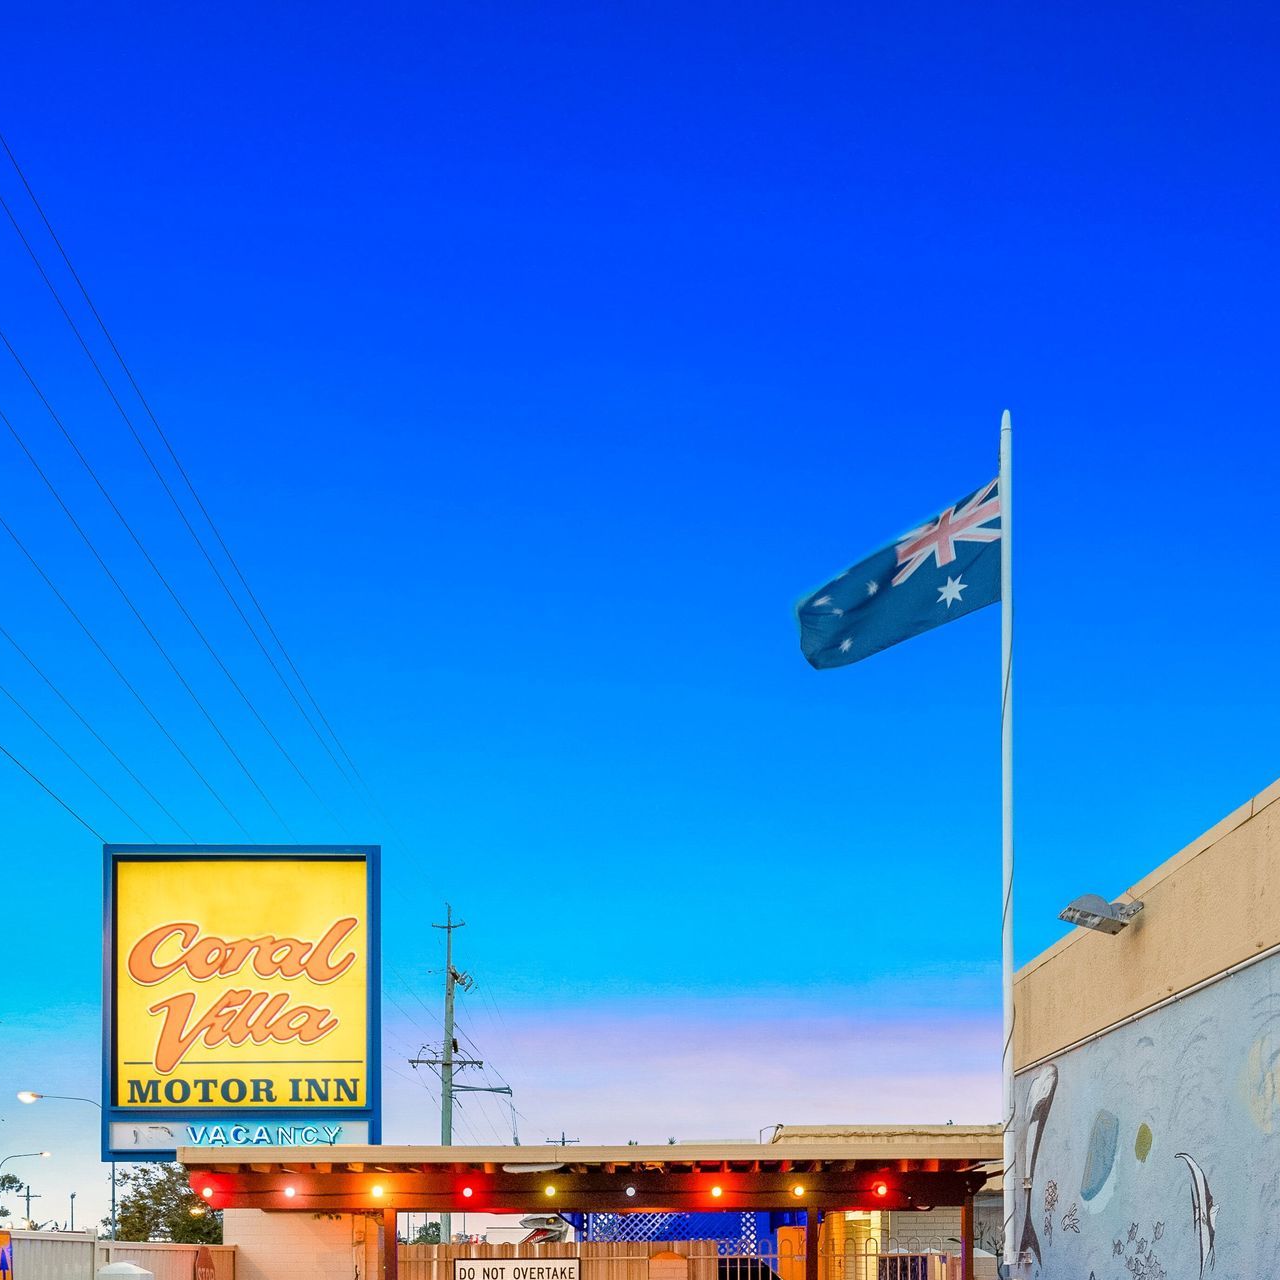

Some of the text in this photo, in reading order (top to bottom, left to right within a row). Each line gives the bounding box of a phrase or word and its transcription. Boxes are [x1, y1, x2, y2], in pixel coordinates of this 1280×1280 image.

[127, 917, 358, 984] Coral
[149, 989, 339, 1074] Villa
[127, 1078, 360, 1104] MOTOR INN
[187, 1125, 342, 1145] VACANCY
[459, 1267, 575, 1280] DO NOT OVERTAKE
